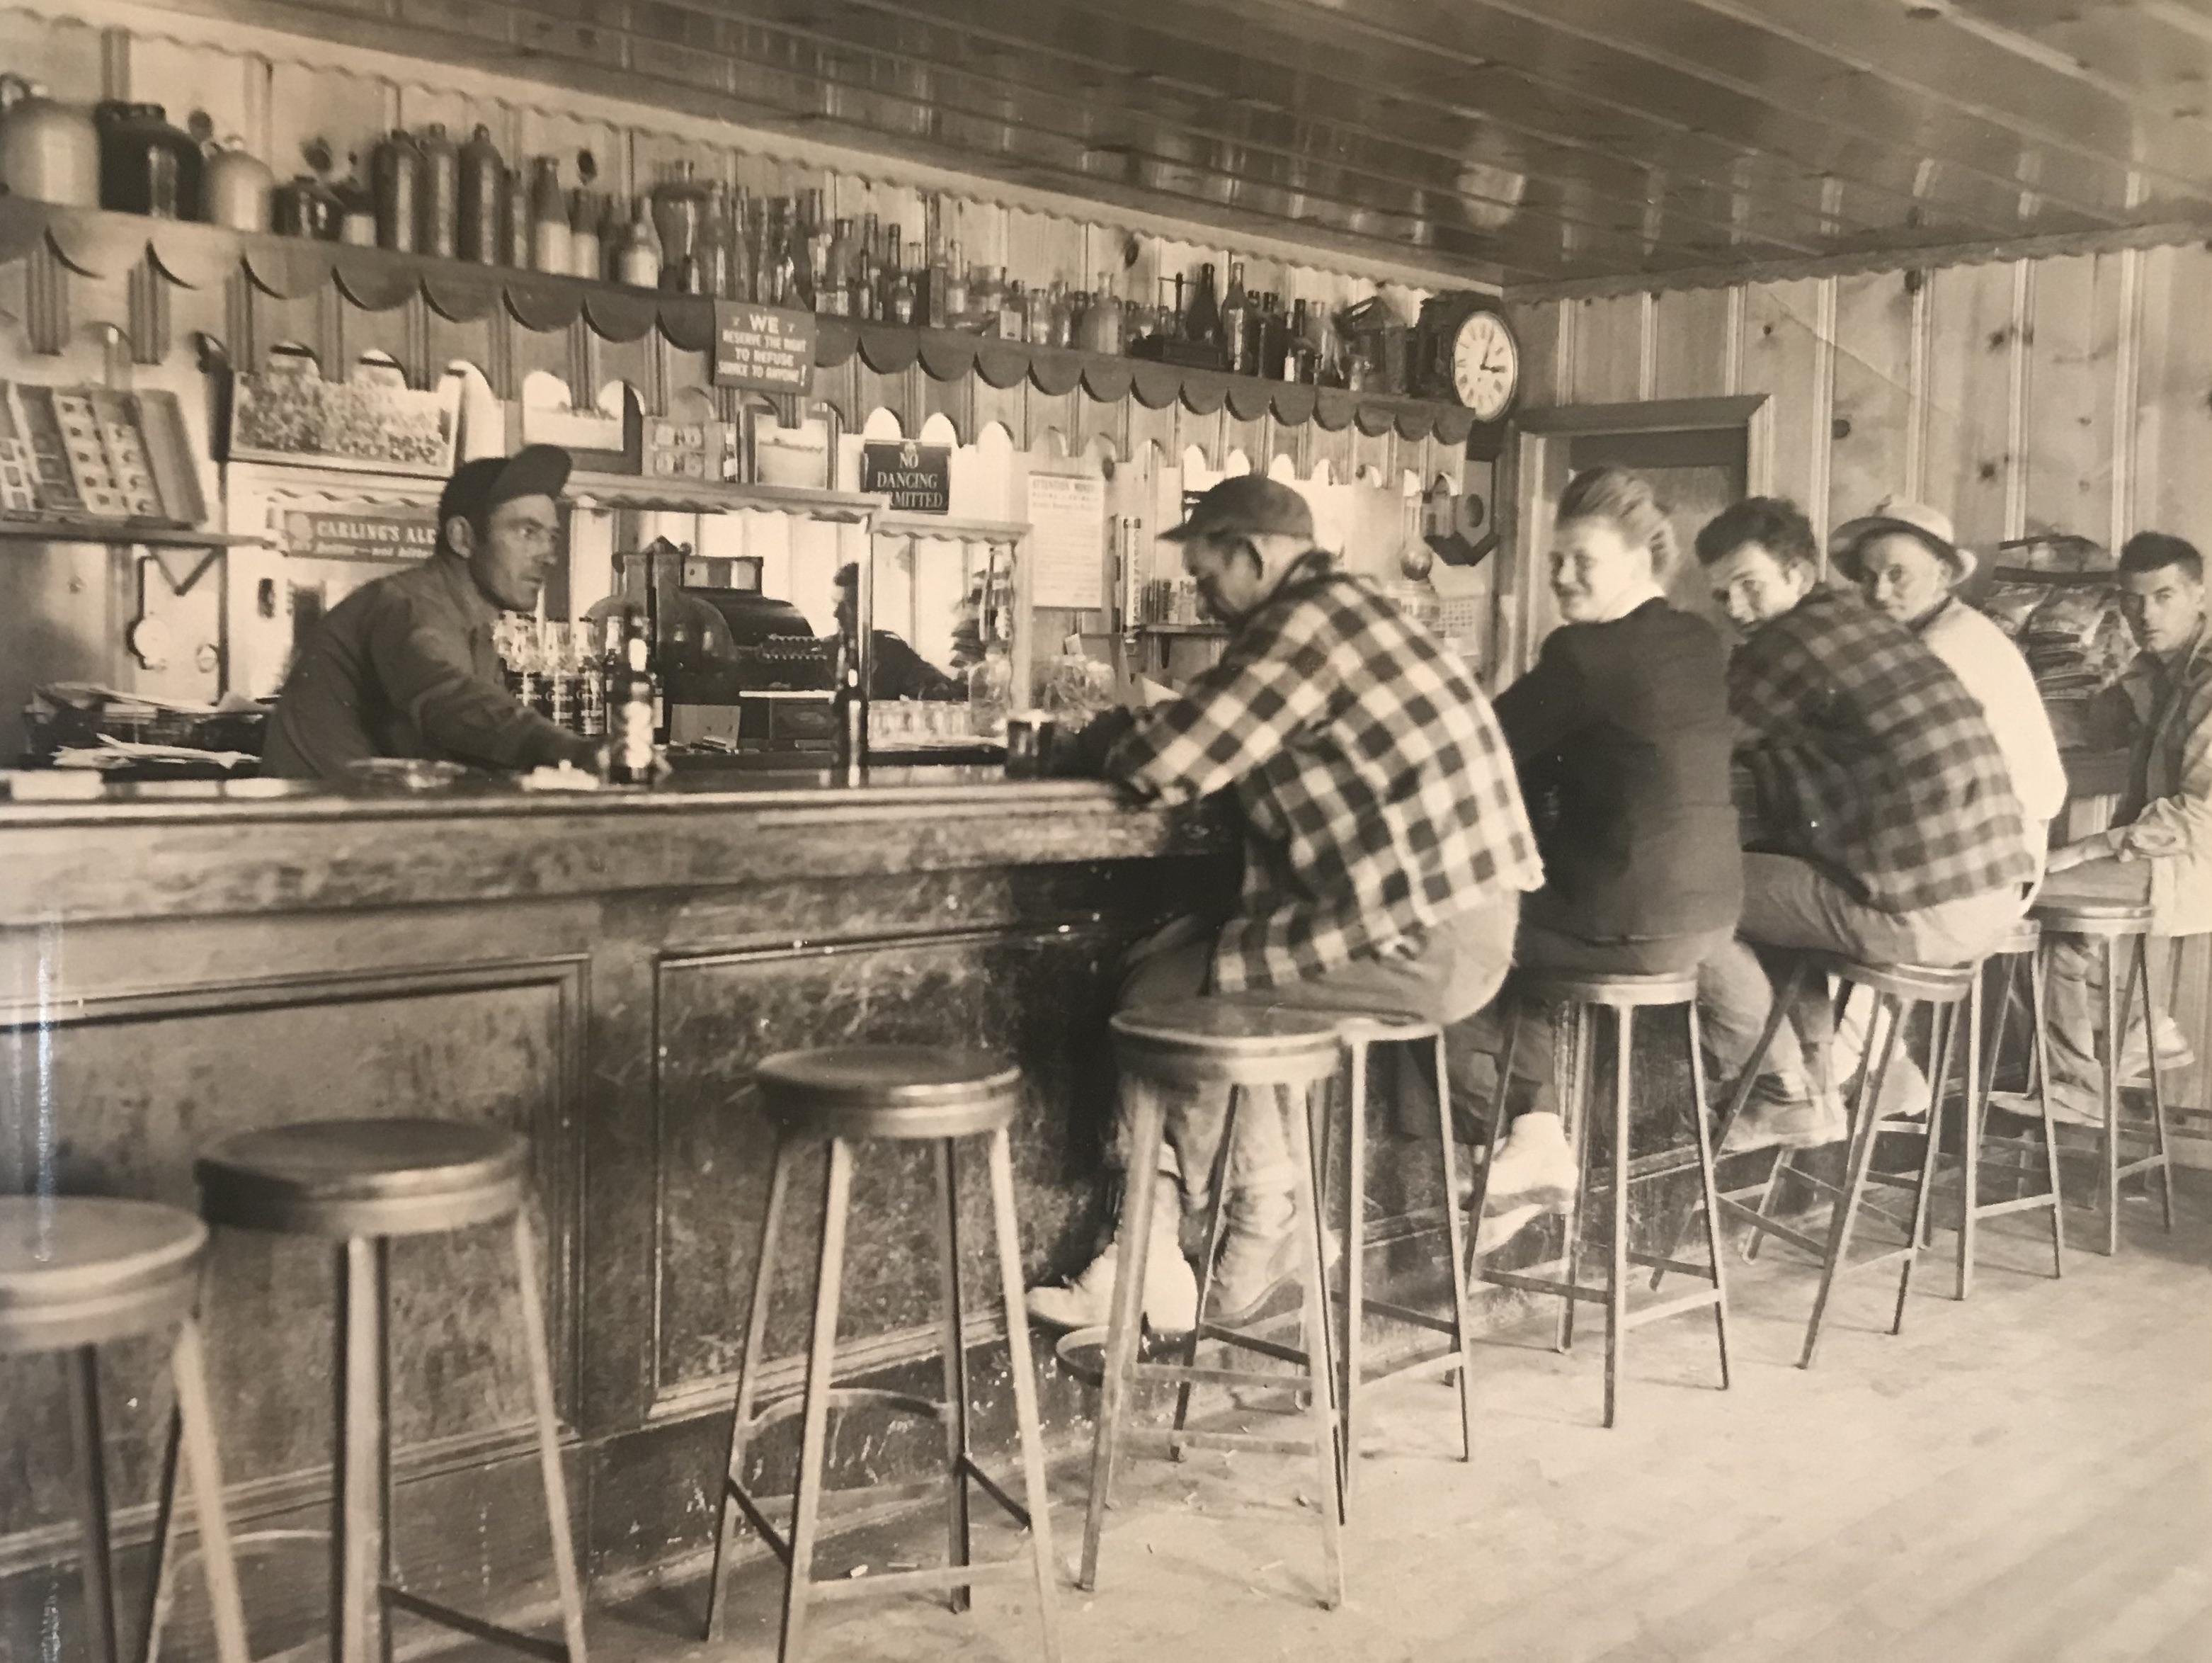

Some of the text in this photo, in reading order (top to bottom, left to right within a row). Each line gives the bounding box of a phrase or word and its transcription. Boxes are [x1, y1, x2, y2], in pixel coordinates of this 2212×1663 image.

[749, 313, 779, 334] WE
[735, 346, 750, 362] TO
[752, 364, 764, 378] TO
[899, 452, 919, 469] NO
[877, 471, 938, 489] DANCING
[406, 526, 436, 545] ALE
